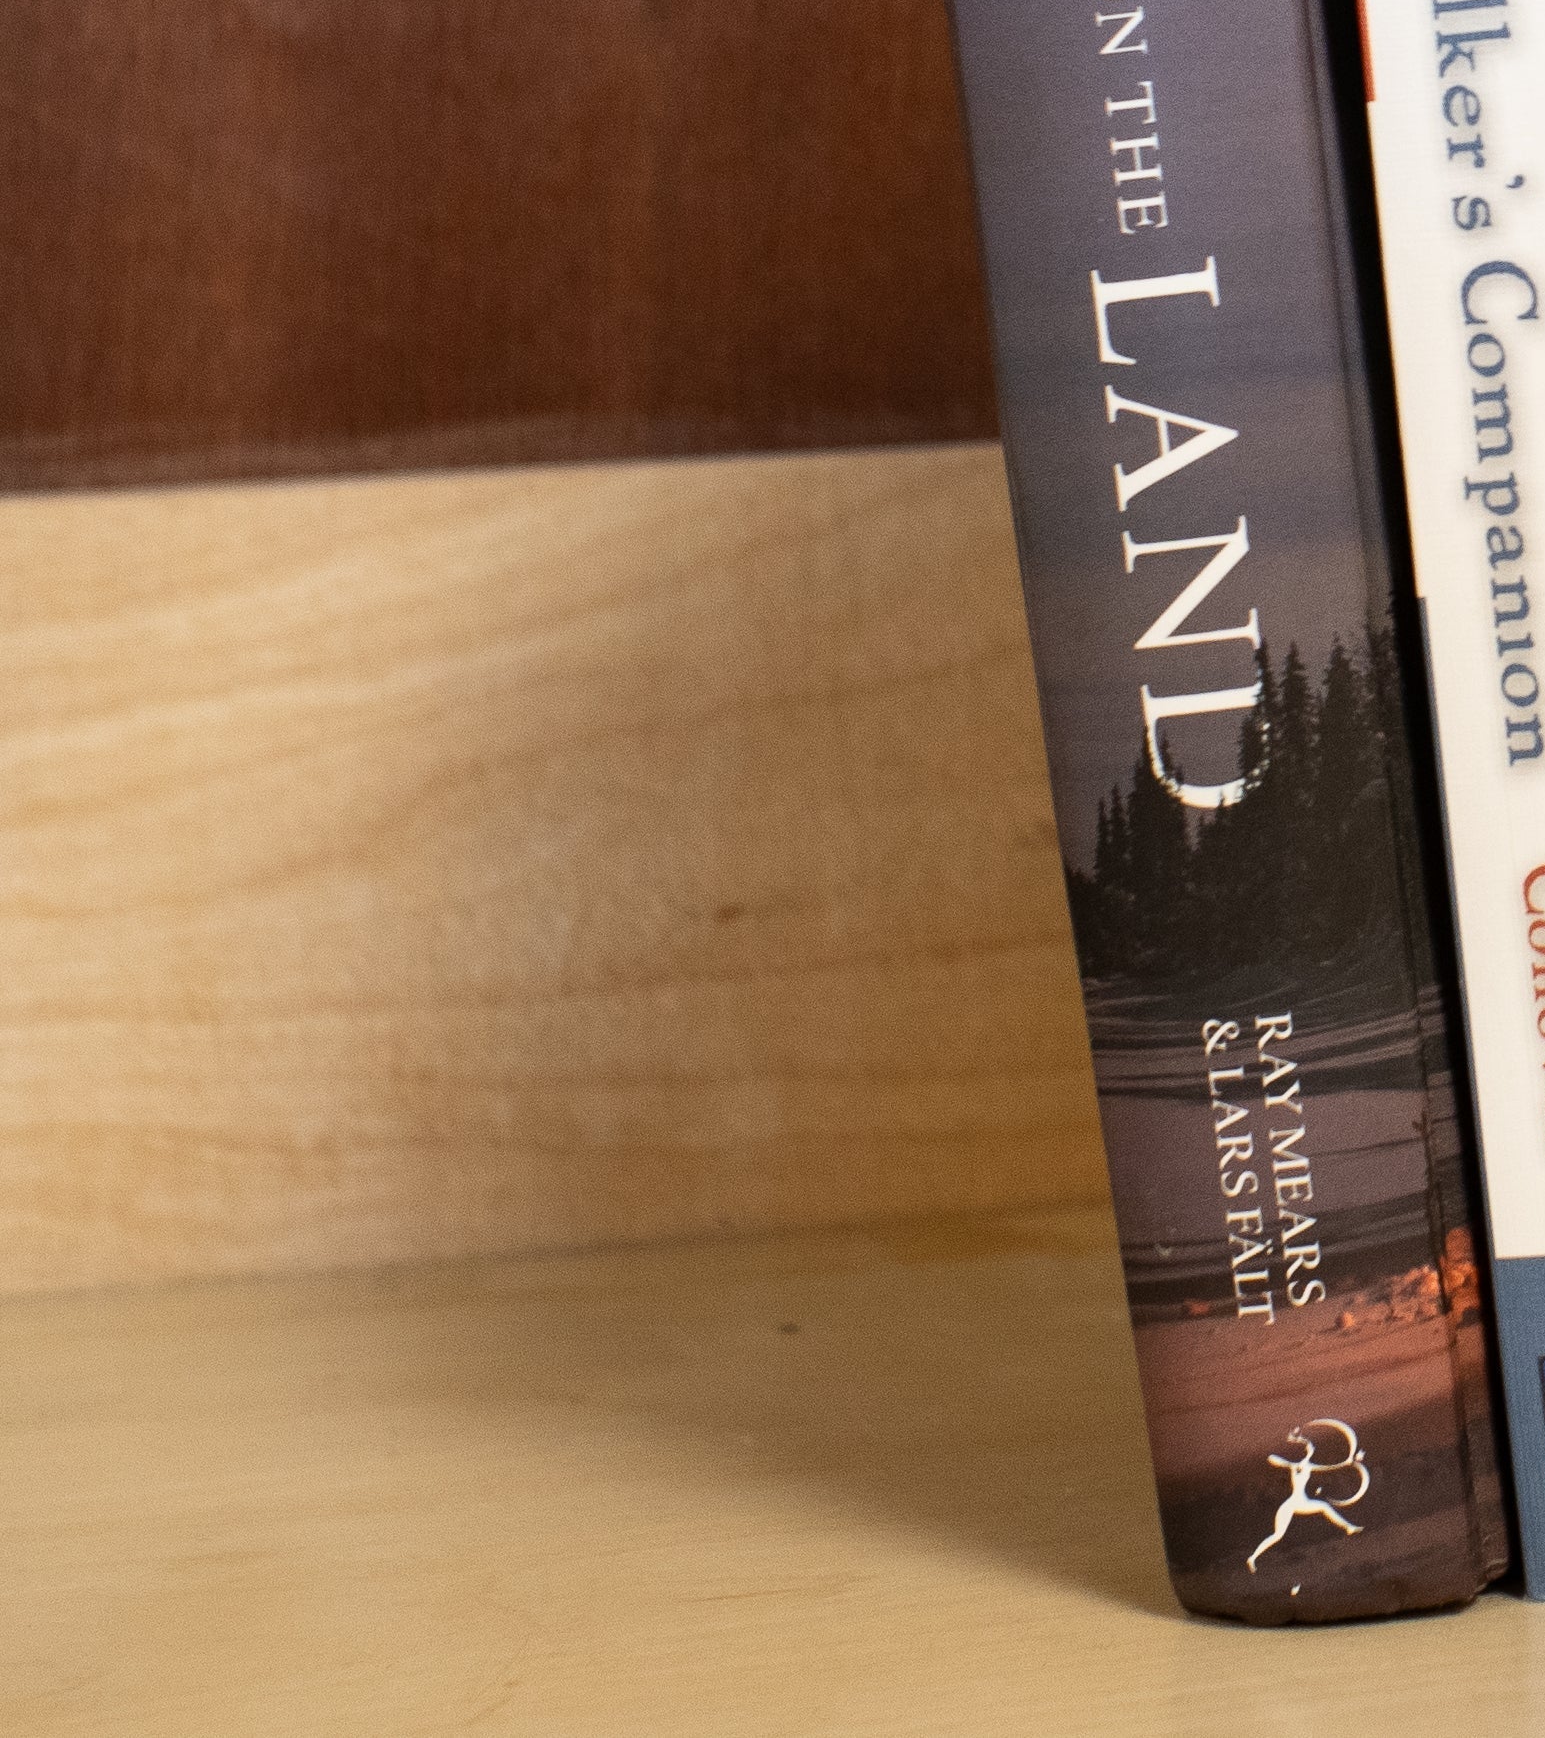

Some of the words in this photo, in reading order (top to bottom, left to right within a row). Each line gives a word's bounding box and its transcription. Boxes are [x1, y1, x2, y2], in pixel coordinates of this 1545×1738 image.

[1106, 81, 1169, 236] THE
[1090, 255, 1270, 809] LAND
[1202, 1019, 1240, 1055] &
[1255, 1012, 1303, 1116] RAY
[1208, 1065, 1260, 1198] LARS
[1268, 1123, 1326, 1308] MEARS
